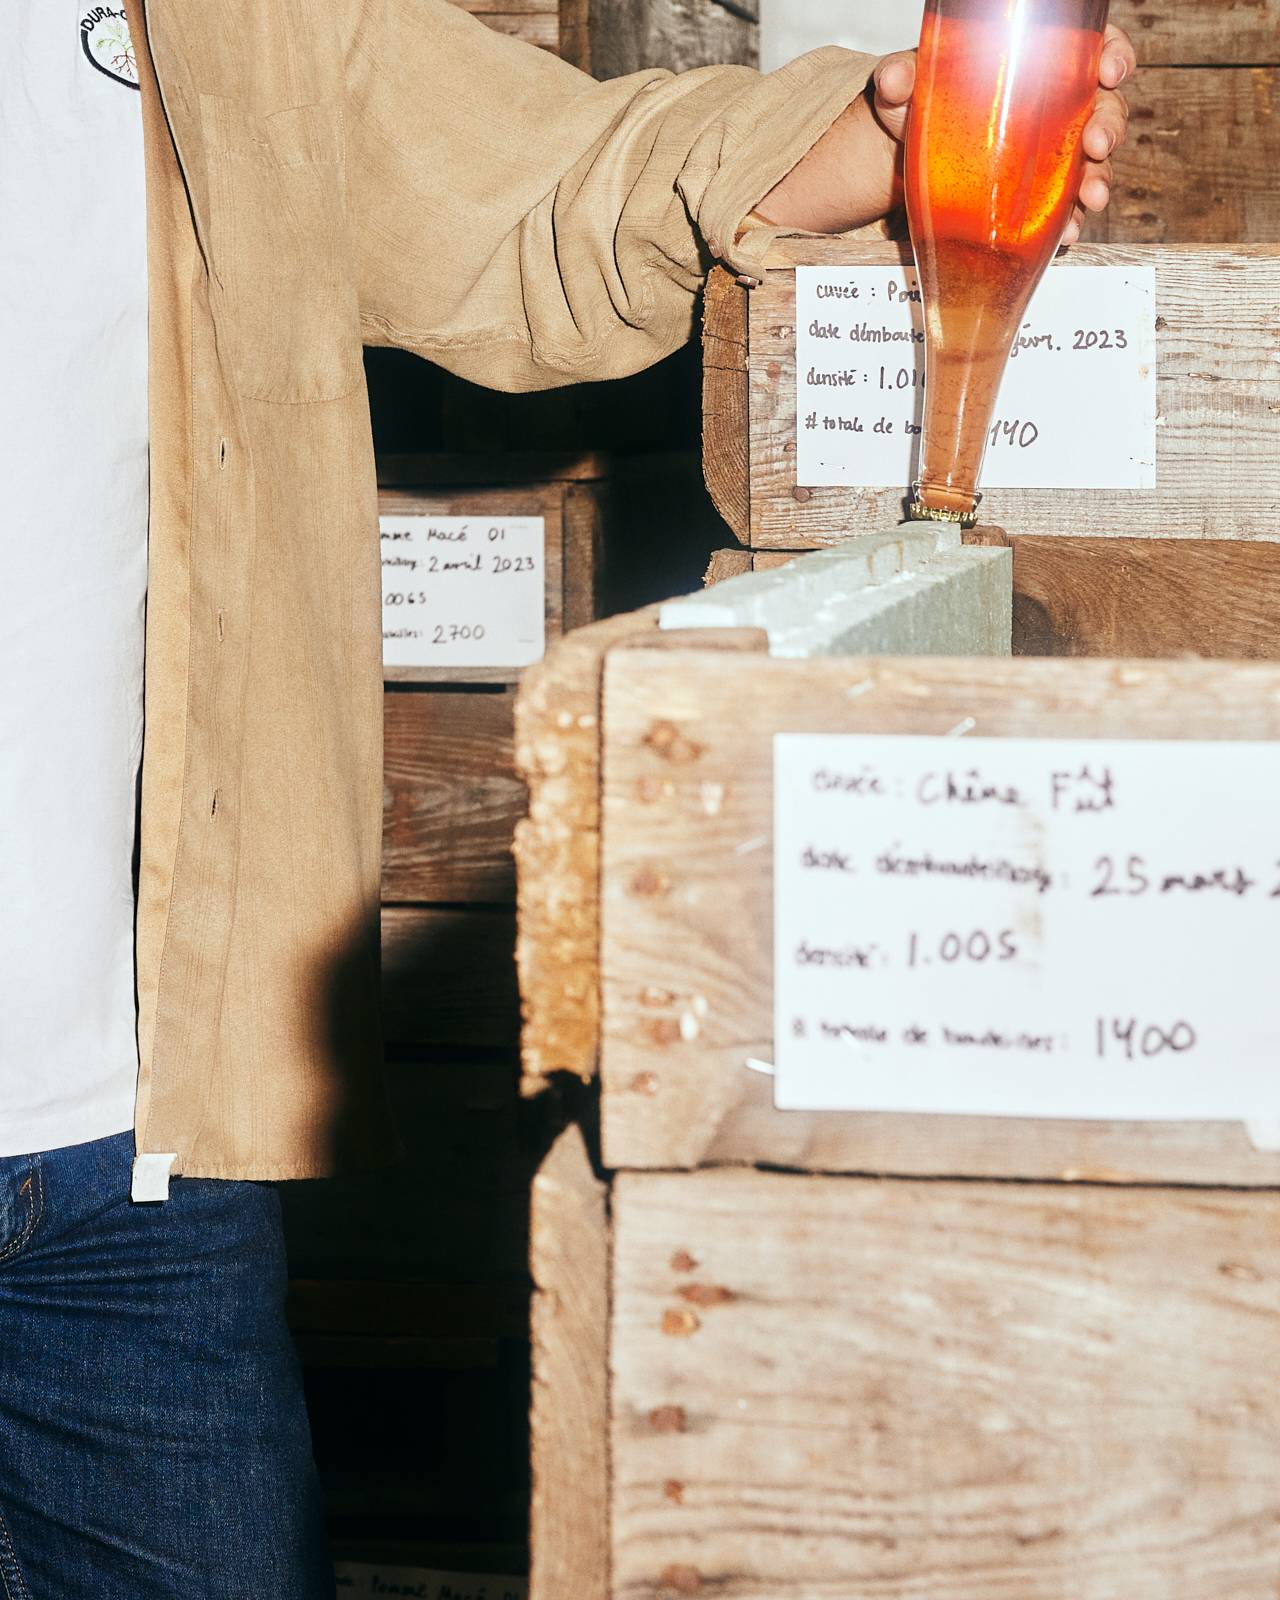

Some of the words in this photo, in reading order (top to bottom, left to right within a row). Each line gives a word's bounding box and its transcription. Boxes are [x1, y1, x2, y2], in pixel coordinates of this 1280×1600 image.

[810, 319, 841, 339] date
[1073, 329, 1128, 350] 2023
[805, 412, 818, 429] #
[823, 416, 863, 433] totale
[873, 417, 893, 434] de
[427, 525, 468, 541] Macé
[488, 527, 505, 541] 01
[428, 556, 439, 573] 2
[443, 554, 482, 571] avril
[492, 556, 534, 574] 2023
[432, 624, 485, 644] 2700
[1091, 855, 1148, 897] 25
[1160, 868, 1254, 896] mars
[907, 930, 1018, 968] 1.005
[1097, 1017, 1197, 1059] 1400
